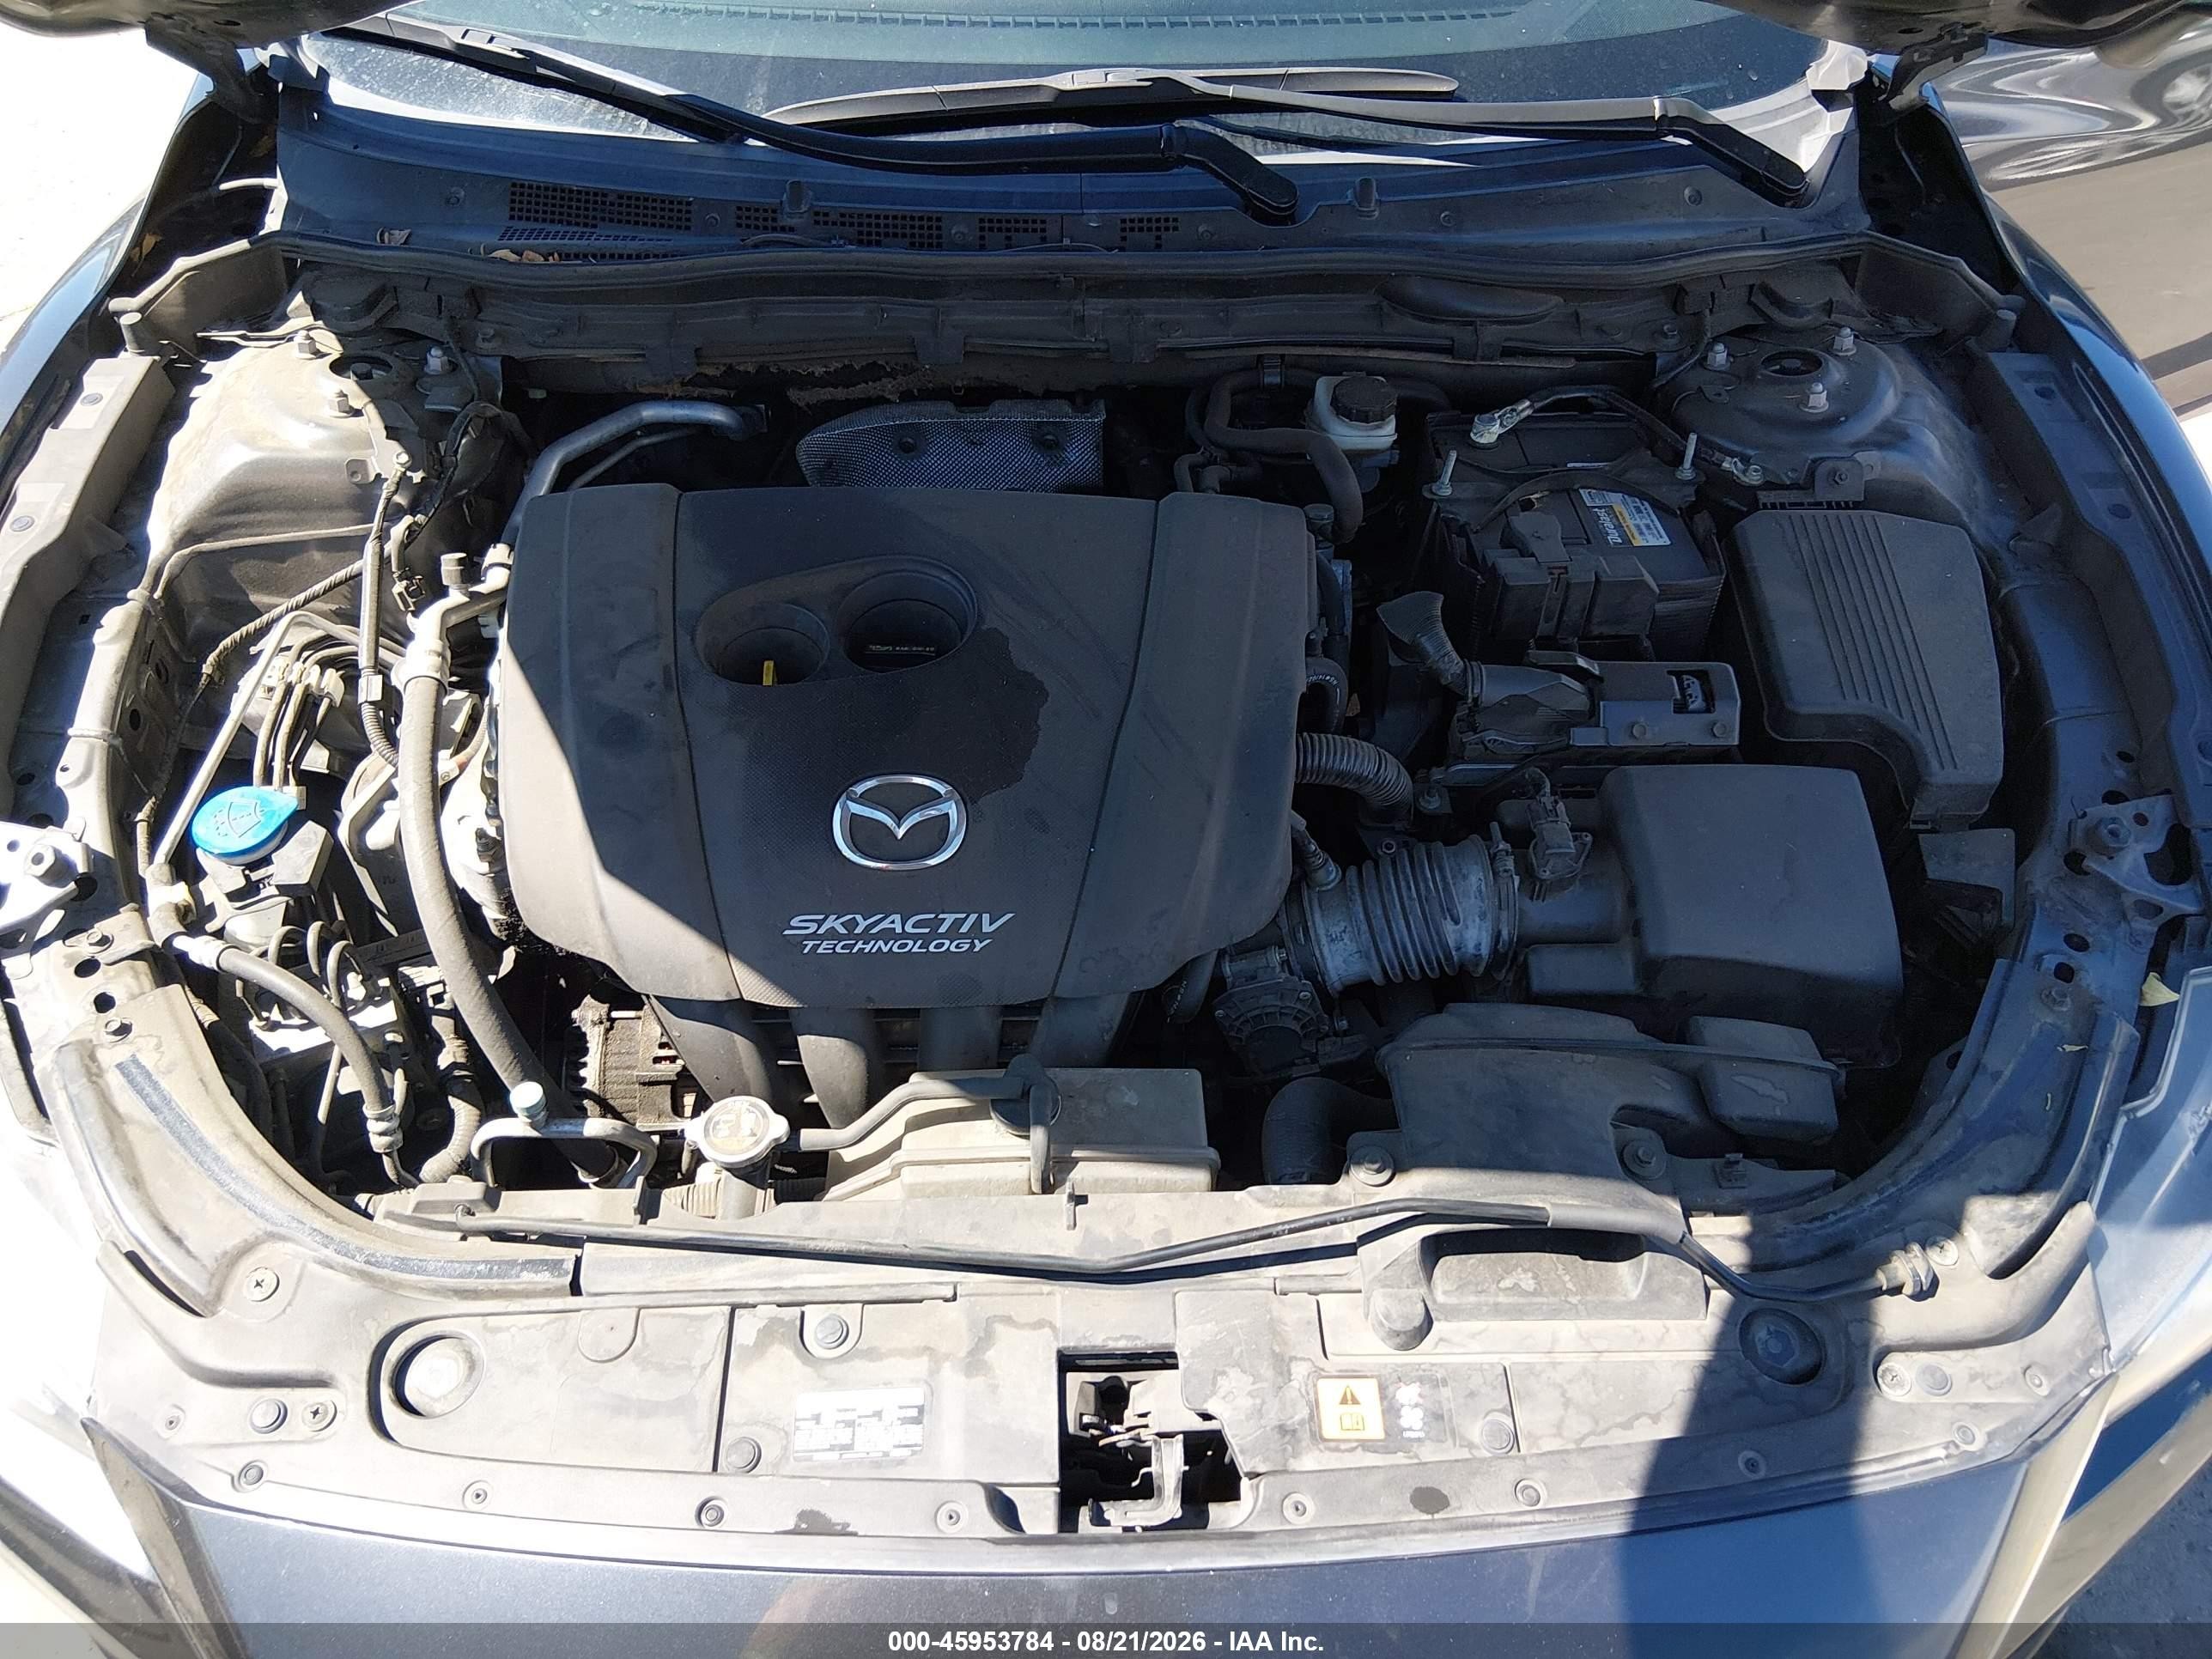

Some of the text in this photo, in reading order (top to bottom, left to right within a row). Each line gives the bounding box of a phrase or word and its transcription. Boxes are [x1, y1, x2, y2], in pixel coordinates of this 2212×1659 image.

[1592, 507, 1623, 544] Duralast
[782, 913, 1016, 935] SKYACTIV
[801, 939, 993, 954] TECHNOLOGY
